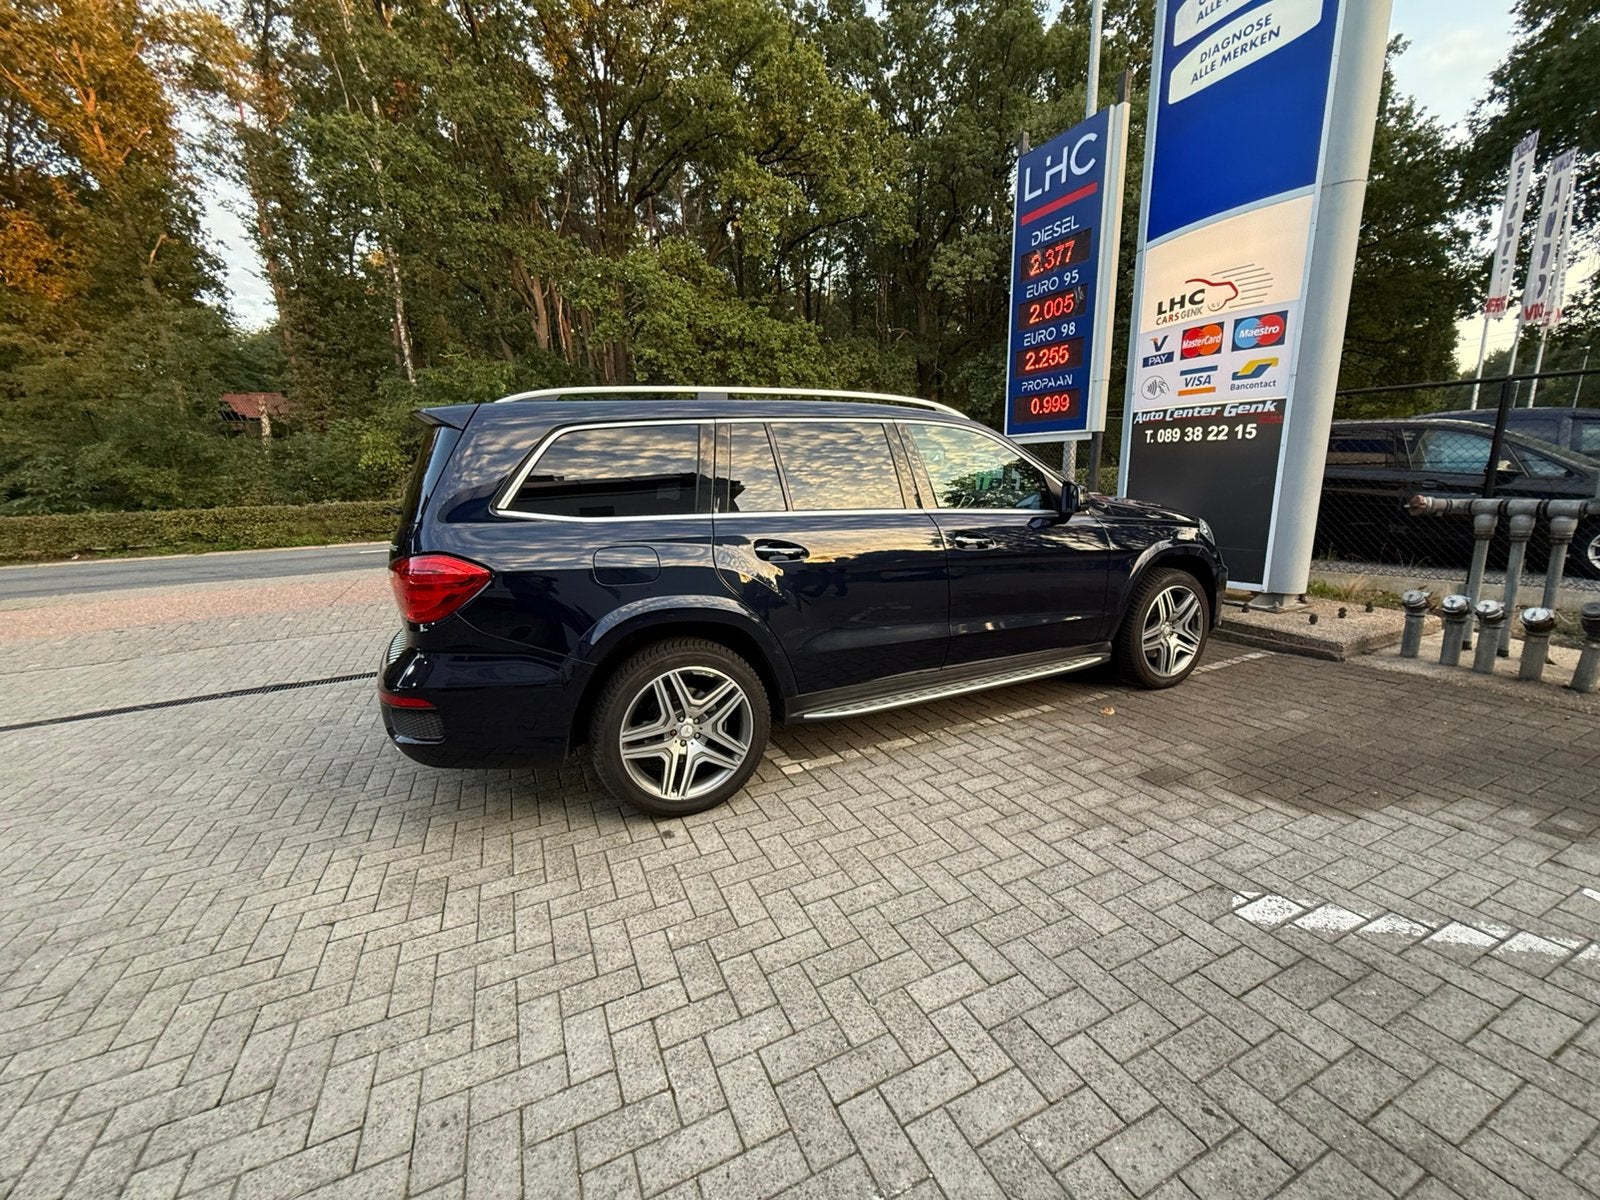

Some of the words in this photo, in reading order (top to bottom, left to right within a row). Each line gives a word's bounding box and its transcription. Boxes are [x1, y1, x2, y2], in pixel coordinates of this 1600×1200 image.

[1196, 0, 1222, 24] ALLE
[1199, 13, 1273, 64] DIAGNOSE
[1190, 60, 1220, 85] ALLE
[1219, 25, 1281, 67] MERKEN
[1024, 132, 1098, 203] LHC
[1031, 215, 1080, 247] DIESEL
[1028, 240, 1075, 277] 2.377
[1026, 276, 1059, 299] EURO
[1063, 269, 1080, 286] 95
[1028, 293, 1075, 325] 2.005
[1157, 289, 1205, 316] LHC
[1023, 327, 1057, 347] EURO
[1061, 321, 1076, 338] 98
[1182, 332, 1223, 350] MasterCard
[1238, 324, 1280, 339] Maestro
[1024, 344, 1070, 371] 2.255
[1148, 353, 1169, 366] PAY
[1021, 374, 1073, 393] PROPAAN
[1184, 374, 1212, 388] VISA
[1230, 379, 1277, 391] Bancontact
[1030, 393, 1070, 415] 0.999
[1133, 411, 1164, 425] Auto
[1165, 406, 1221, 421] Center
[1223, 400, 1278, 418] Genk
[1156, 427, 1181, 443] 089
[1183, 426, 1203, 442] 38
[1206, 425, 1229, 441] 22
[1234, 423, 1257, 440] 15
